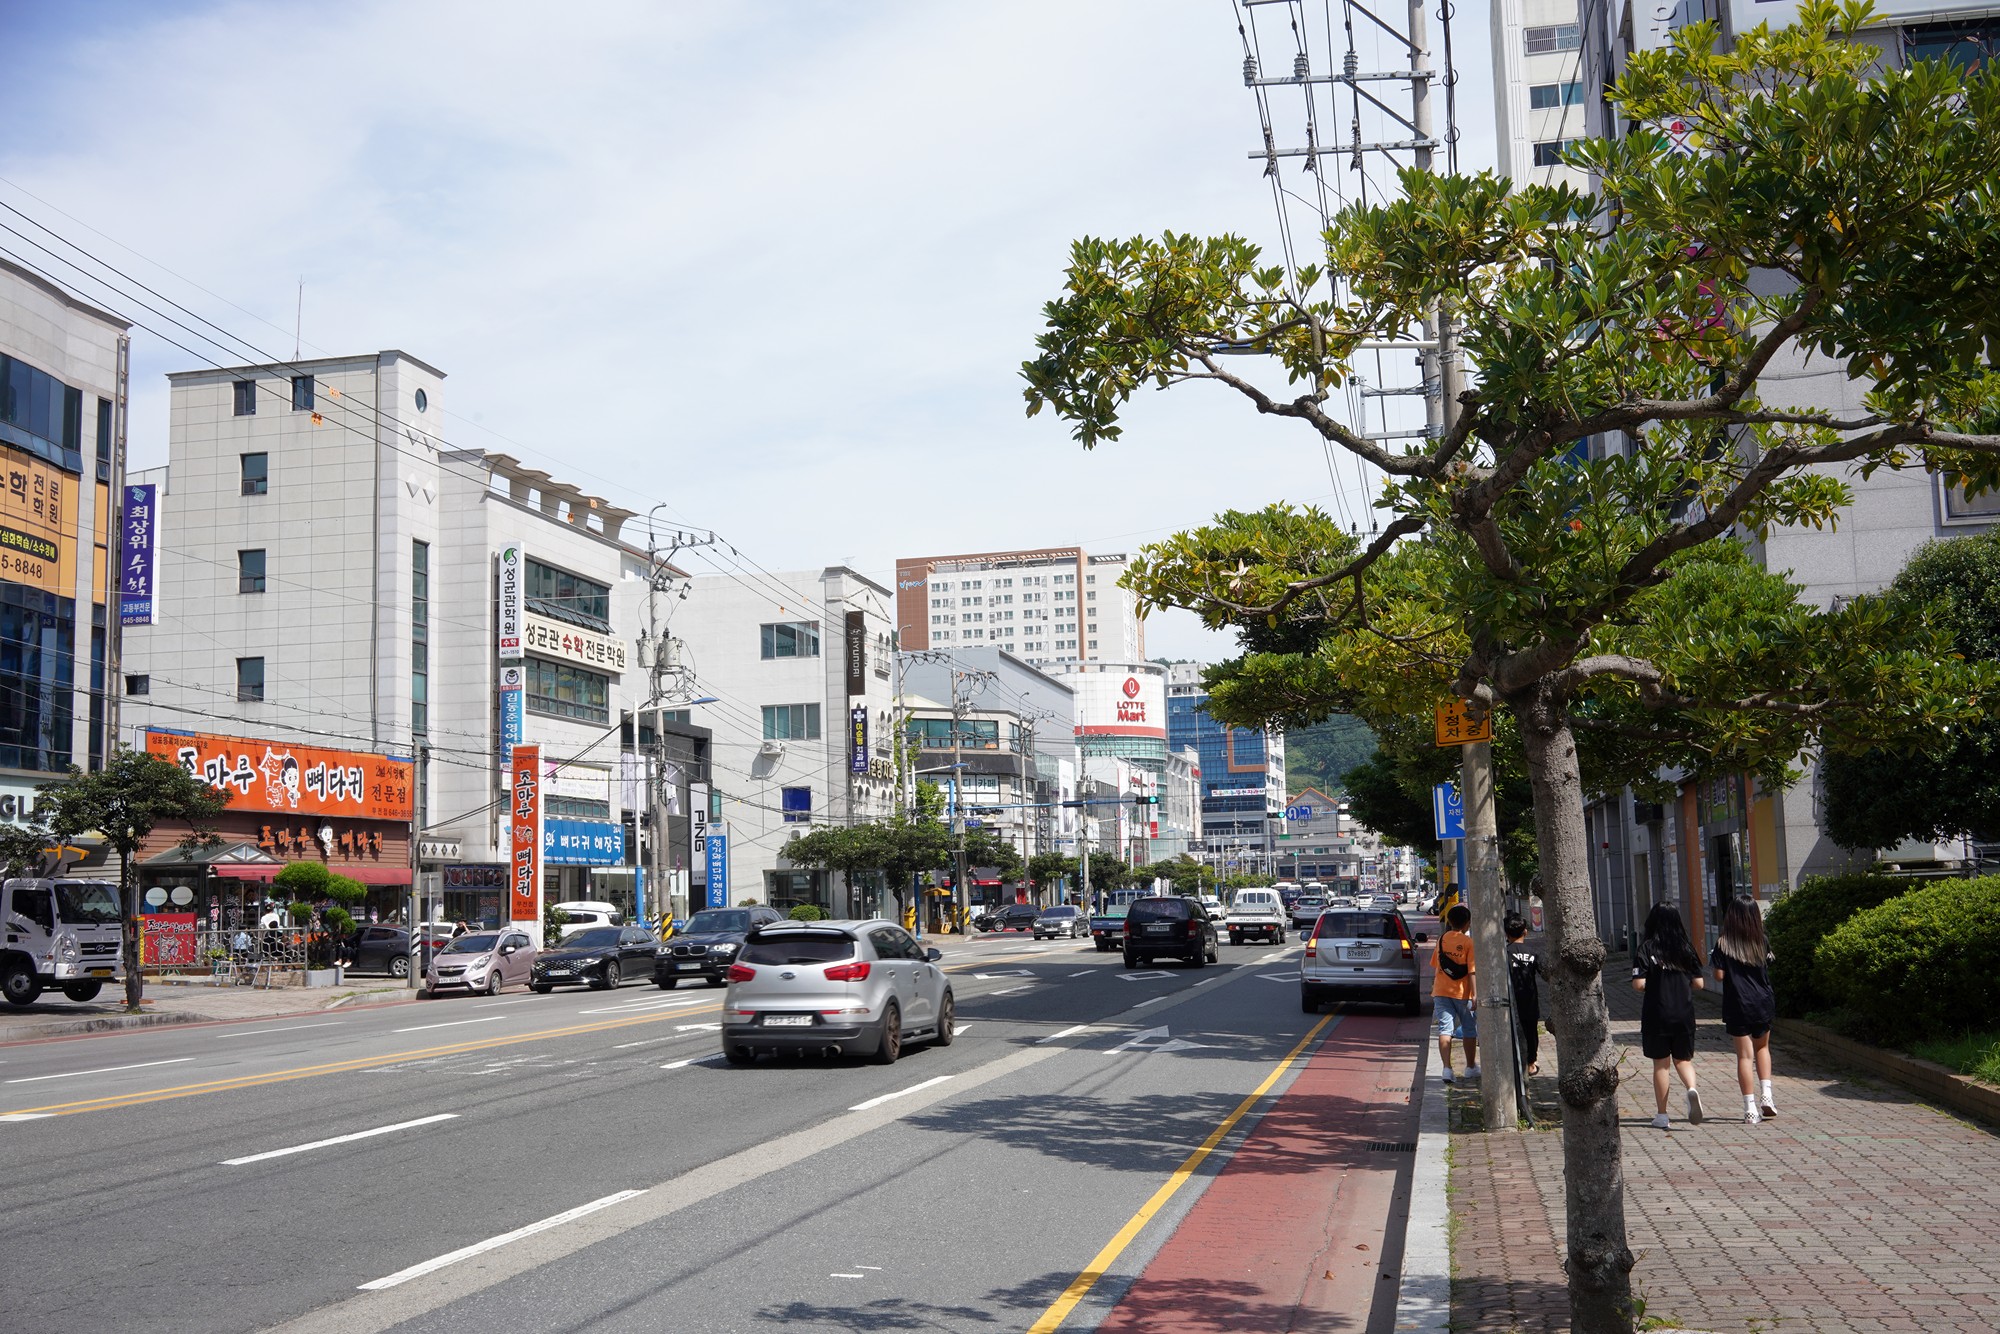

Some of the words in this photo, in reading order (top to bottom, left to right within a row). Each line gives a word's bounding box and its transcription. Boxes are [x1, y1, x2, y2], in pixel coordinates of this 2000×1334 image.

[129, 505, 150, 549] 최상위
[128, 554, 147, 597] 수학
[123, 616, 150, 624] 645-8848
[504, 568, 517, 635] 성균관학원
[503, 638, 517, 647] 수학
[525, 623, 559, 650] 성균관
[562, 633, 584, 659] 수학
[586, 639, 625, 669] 전문학원
[852, 637, 860, 677] HYUNDAI
[1117, 701, 1145, 710] LOTTE
[1117, 709, 1146, 722] Mart
[306, 762, 364, 803] 뼈다귀
[371, 783, 406, 804] 전문점
[516, 770, 536, 819] 조마루
[977, 779, 996, 790] 카페
[258, 825, 310, 849] 조마루
[341, 829, 383, 853] 뼈다귀
[560, 835, 590, 851] 뼈다귀
[594, 836, 622, 854] 해장국
[694, 810, 705, 852] PING
[516, 848, 534, 897] 뼈다귀
